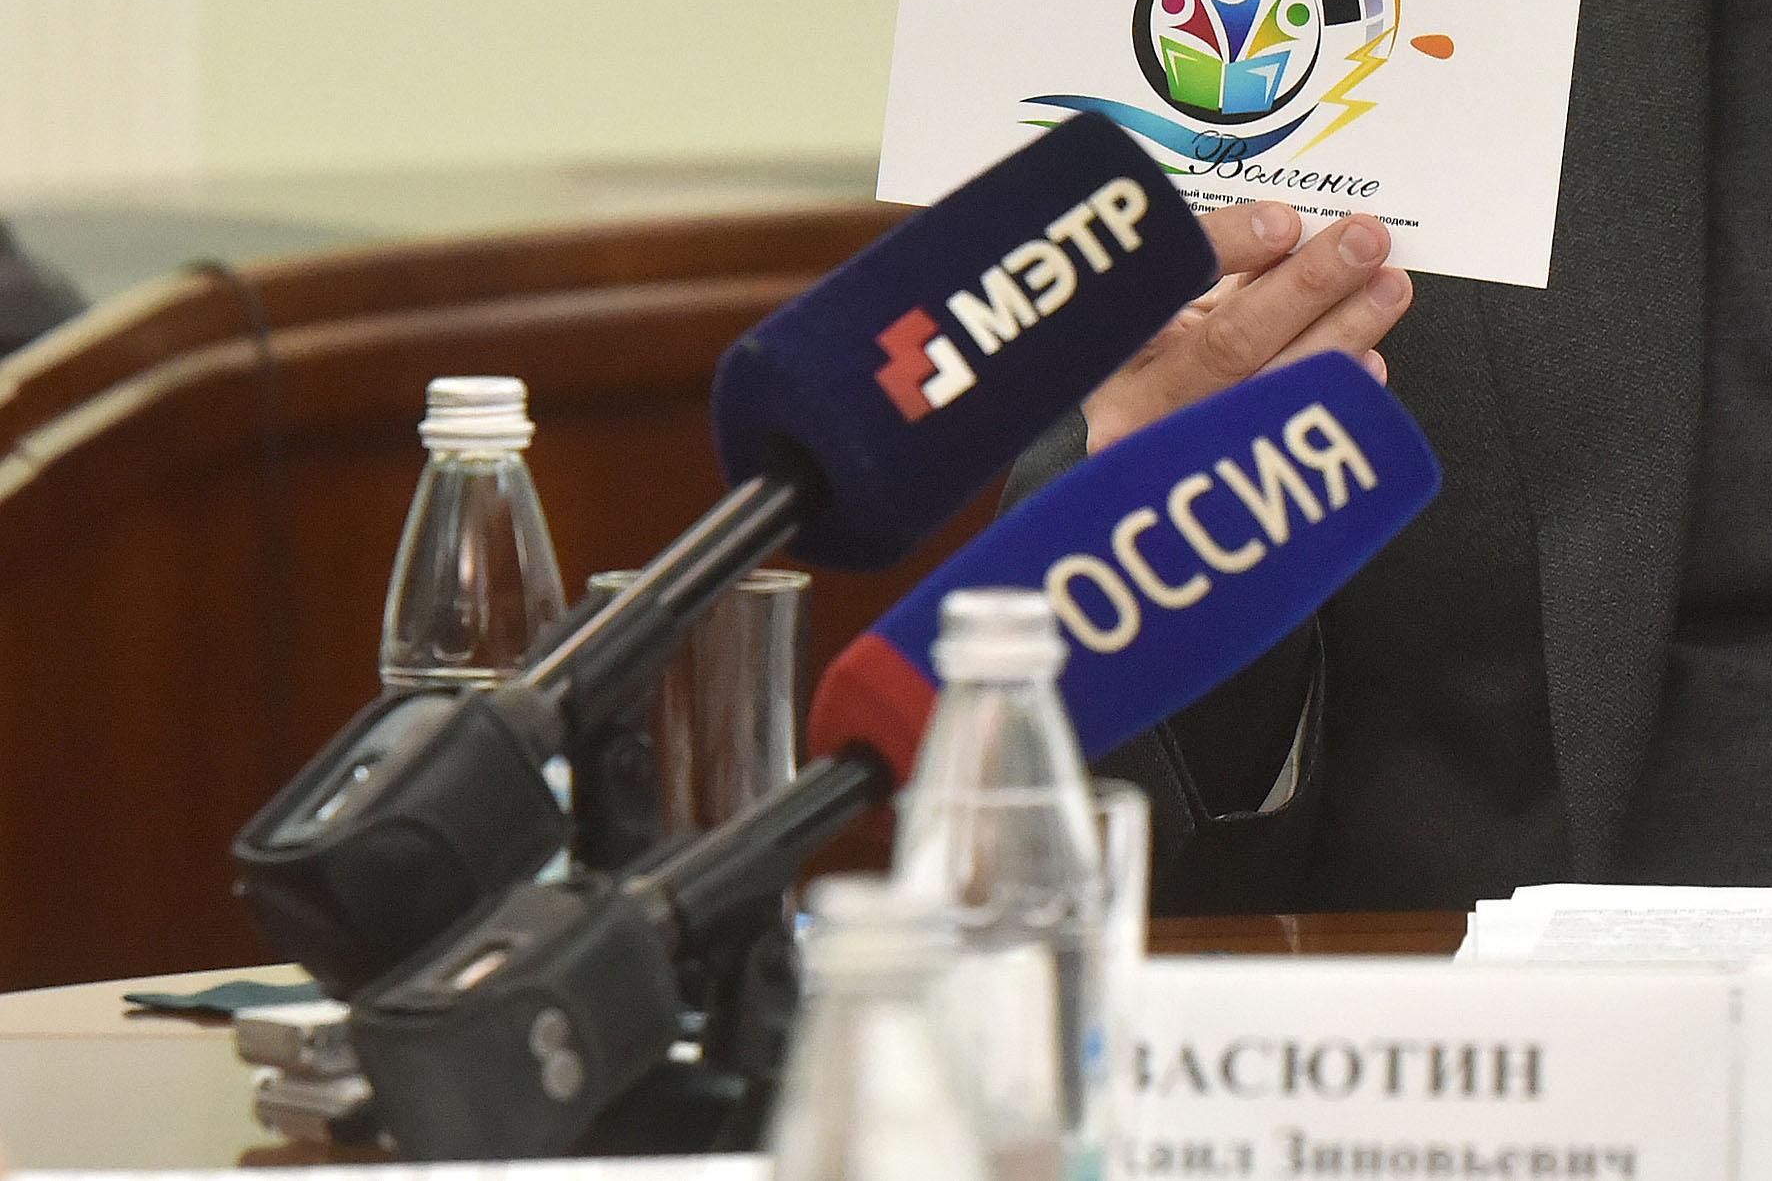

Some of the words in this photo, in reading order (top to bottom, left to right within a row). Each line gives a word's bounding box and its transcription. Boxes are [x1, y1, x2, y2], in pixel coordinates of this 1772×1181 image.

[1177, 188, 1200, 198] ный
[1202, 191, 1234, 204] центр
[1290, 203, 1319, 215] нных
[1374, 215, 1420, 228] лодежи
[1188, 130, 1380, 198] Волгенче
[946, 175, 1151, 356] МЭТР
[1044, 401, 1379, 655] ОССИЯ
